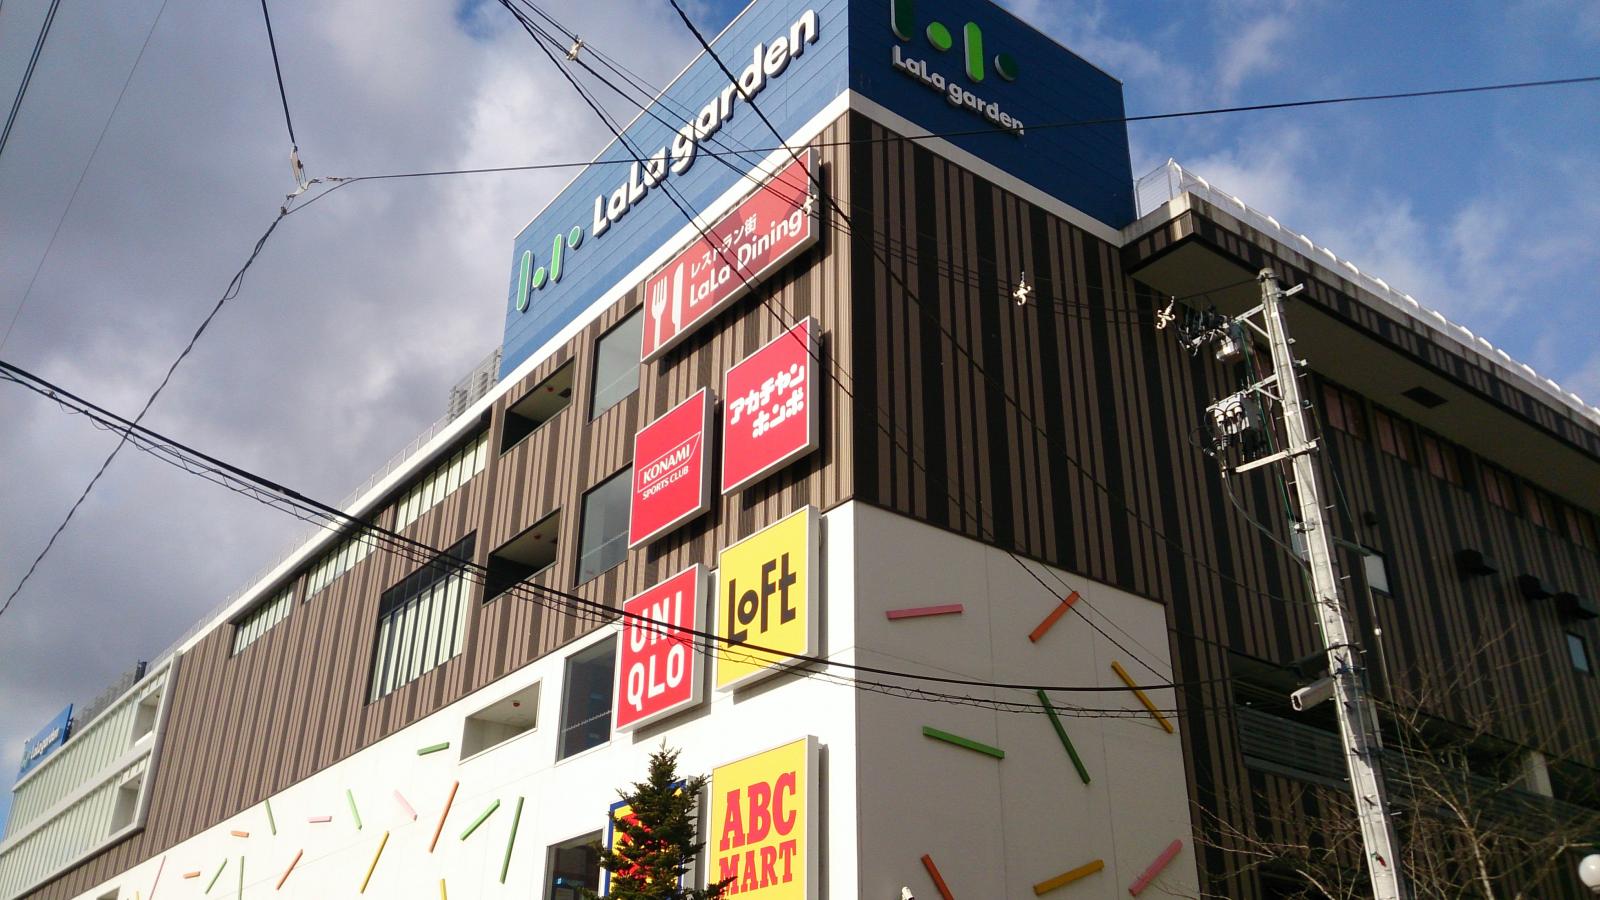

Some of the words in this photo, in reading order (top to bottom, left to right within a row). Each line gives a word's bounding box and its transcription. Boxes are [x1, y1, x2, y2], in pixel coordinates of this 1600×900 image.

[690, 214, 757, 278] レストラン街
[690, 263, 731, 308] LaLa
[736, 210, 804, 274] Dining
[729, 363, 805, 425] アカチャン
[642, 478, 669, 500] SPORTS
[669, 465, 689, 483] CLUB
[643, 443, 690, 484] KONAMI
[630, 591, 683, 653] UNI
[627, 643, 686, 712] QLO
[719, 771, 797, 851] ABC
[719, 838, 797, 898] MART
